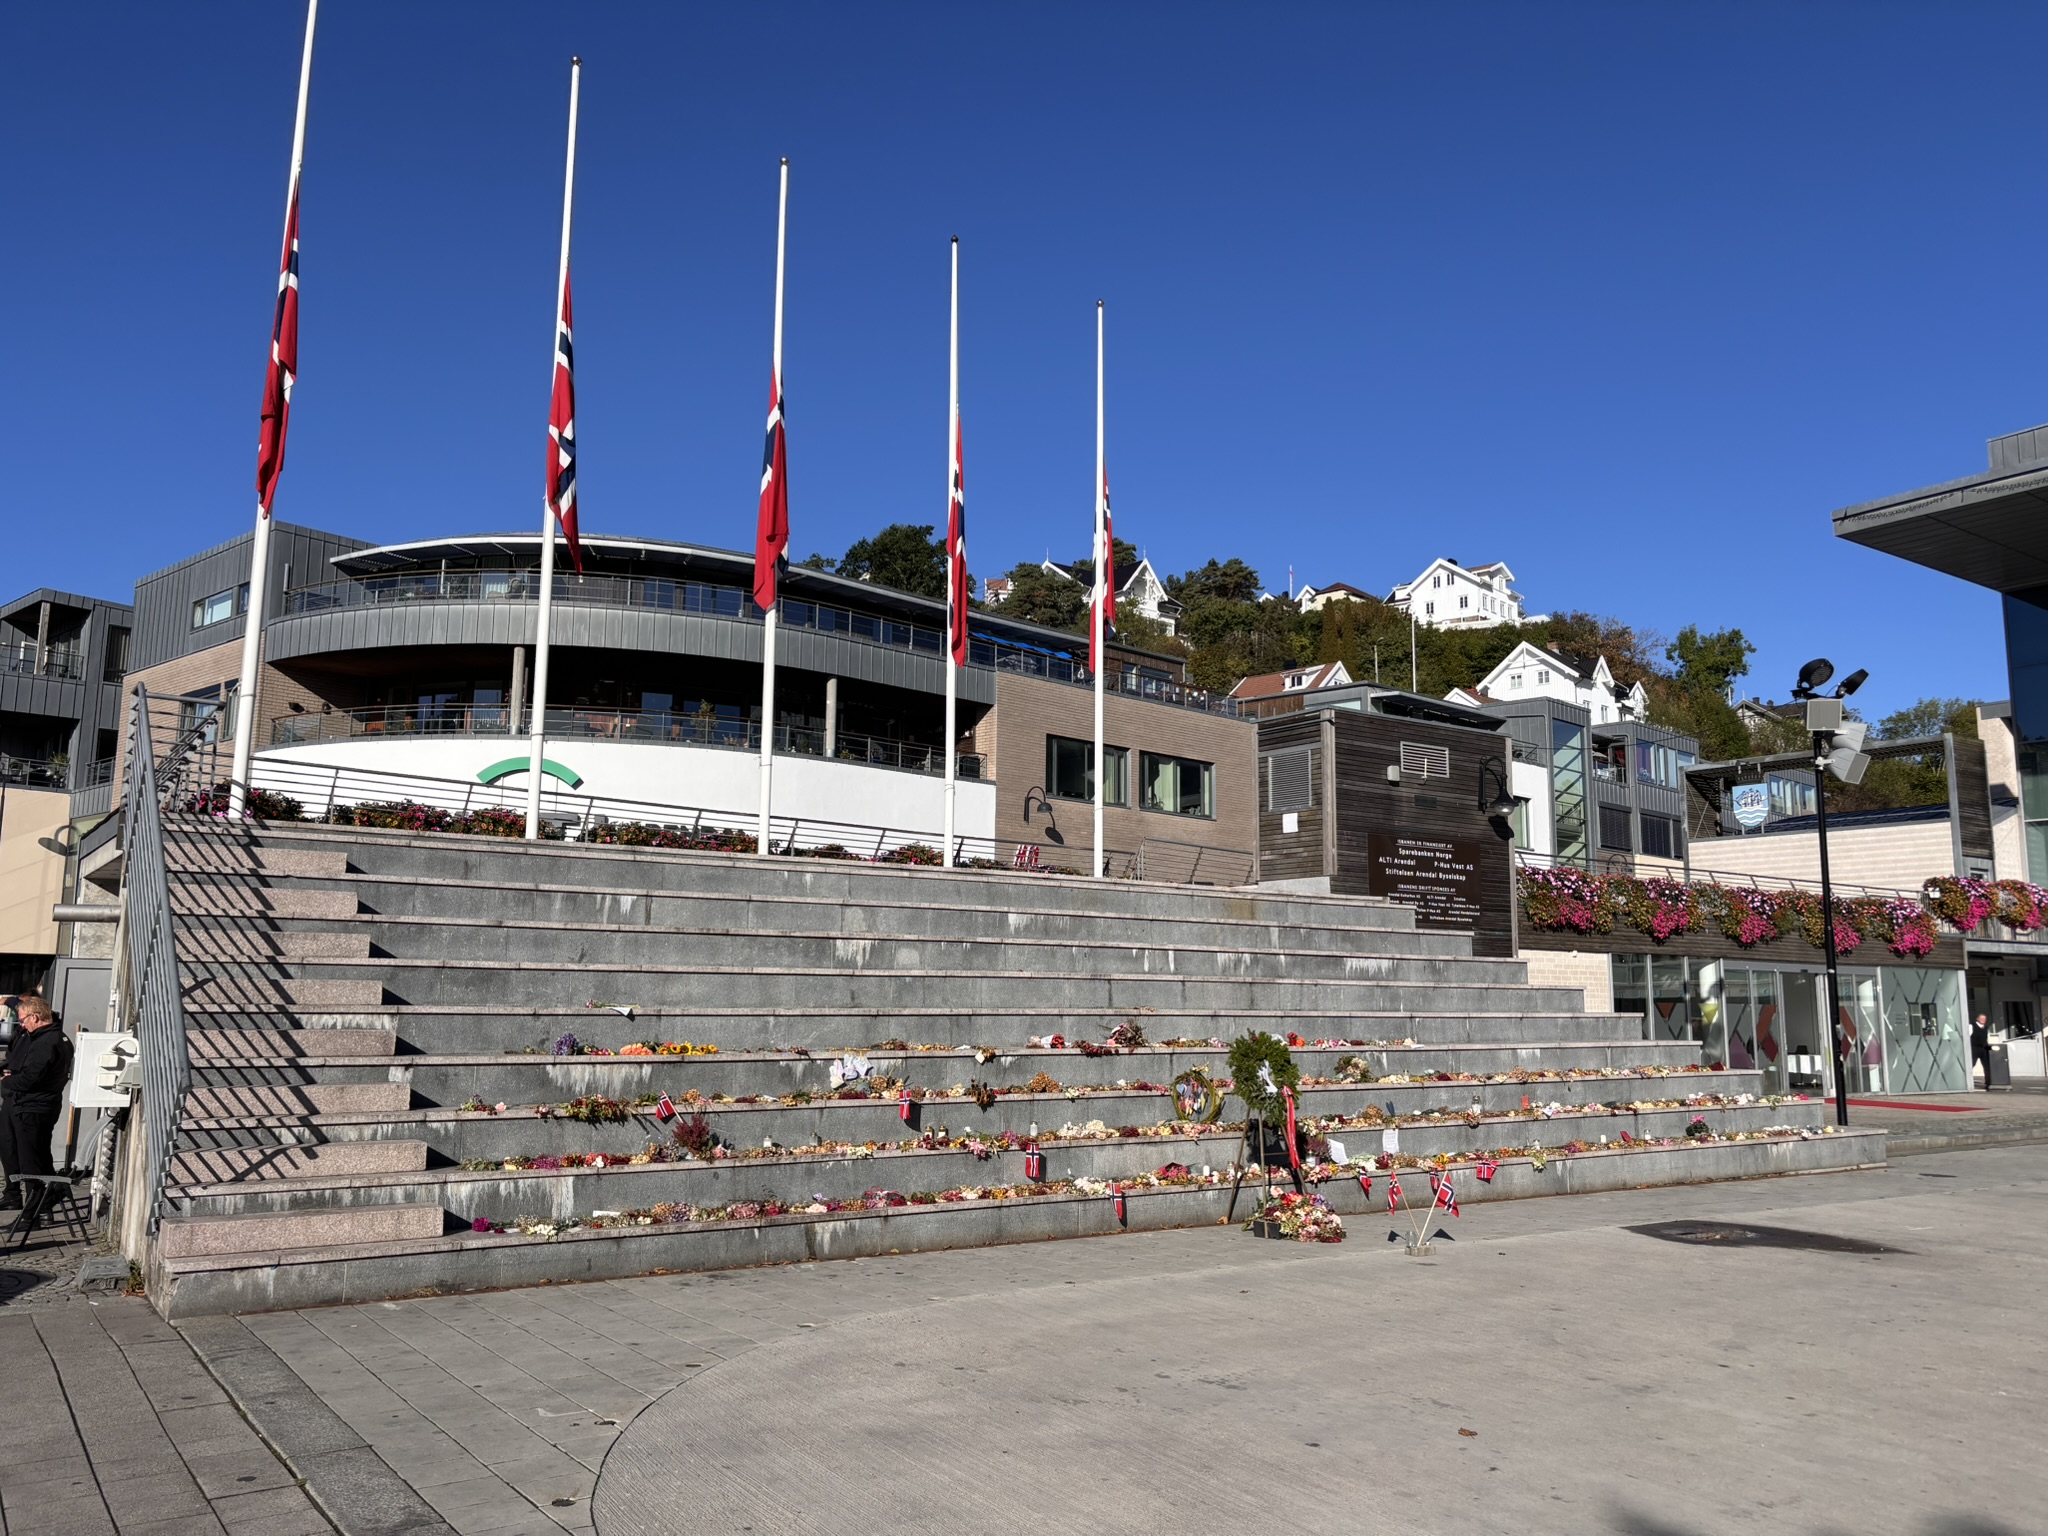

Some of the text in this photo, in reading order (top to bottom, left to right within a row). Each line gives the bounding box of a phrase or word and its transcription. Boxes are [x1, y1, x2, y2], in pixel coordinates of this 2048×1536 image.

[1398, 848, 1434, 858] Sparebanken
[1386, 868, 1414, 876] Stiftelsen
[1439, 873, 1466, 881] Byselskap
